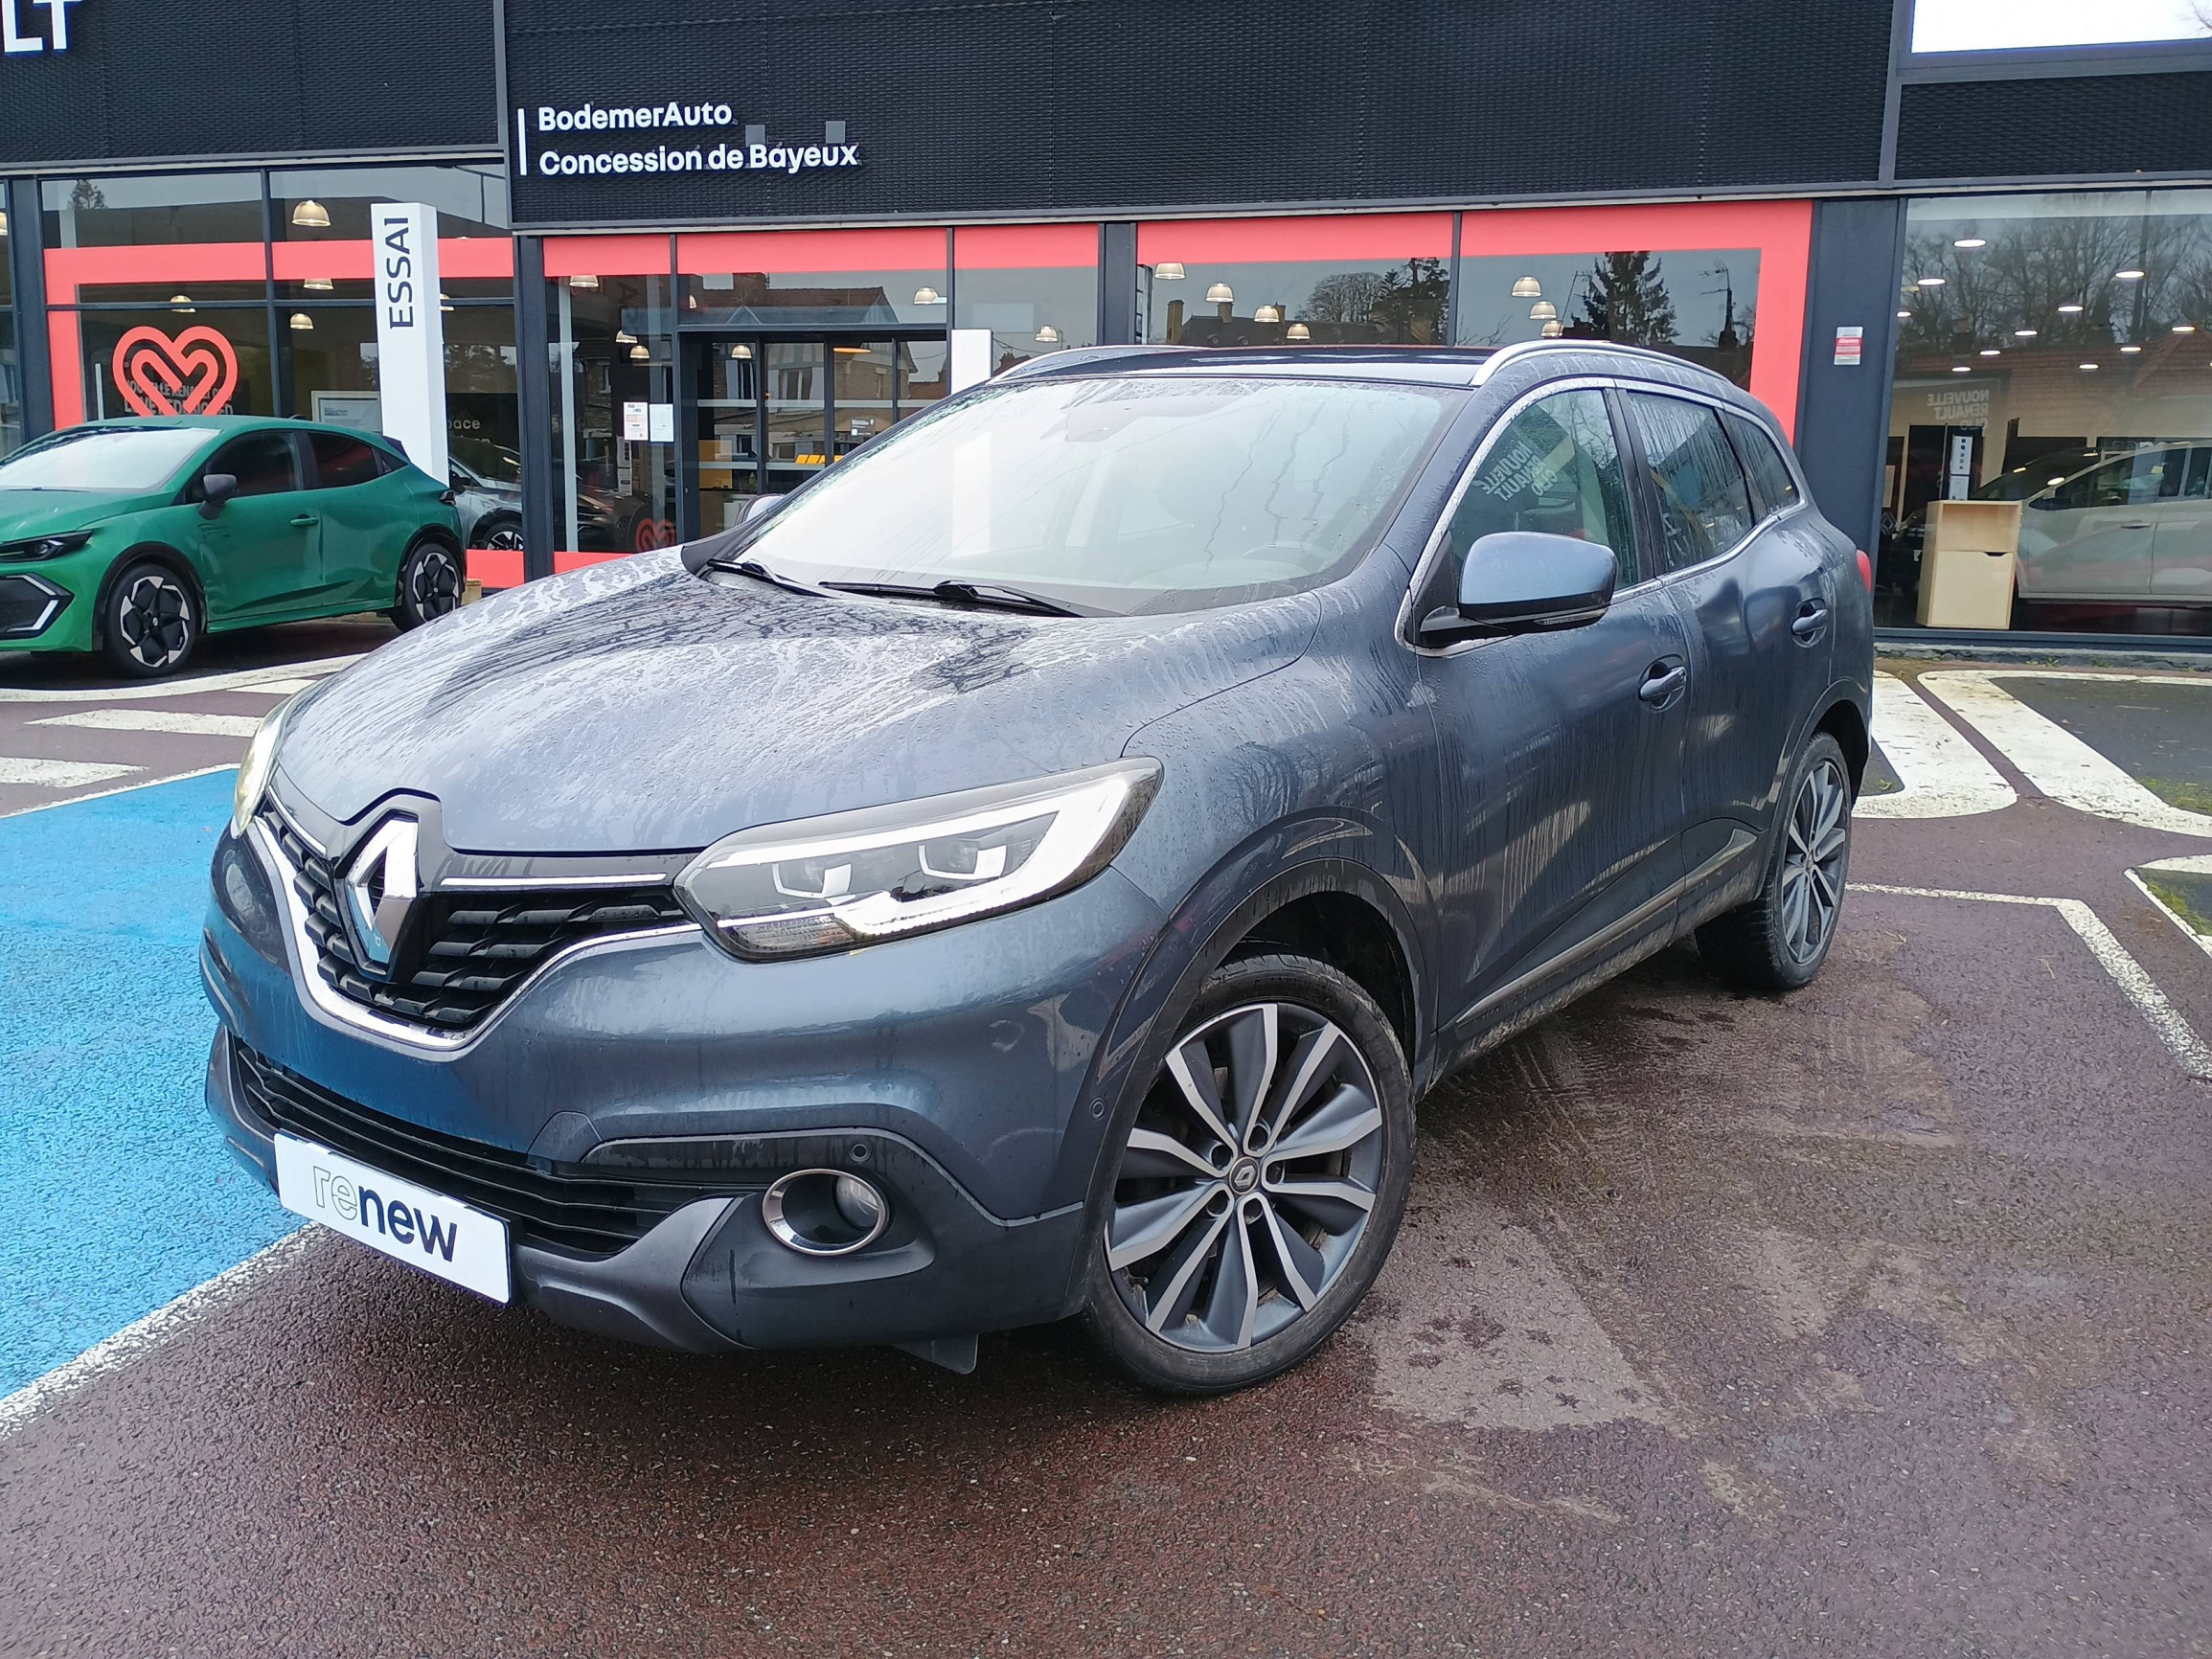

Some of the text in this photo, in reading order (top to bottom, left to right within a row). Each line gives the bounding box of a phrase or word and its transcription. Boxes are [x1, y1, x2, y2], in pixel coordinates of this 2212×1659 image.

[538, 102, 732, 131] BodemerAuto
[539, 143, 858, 175] Concession de Bayeux
[384, 217, 413, 329] ESSAI
[313, 1166, 457, 1263] renew
